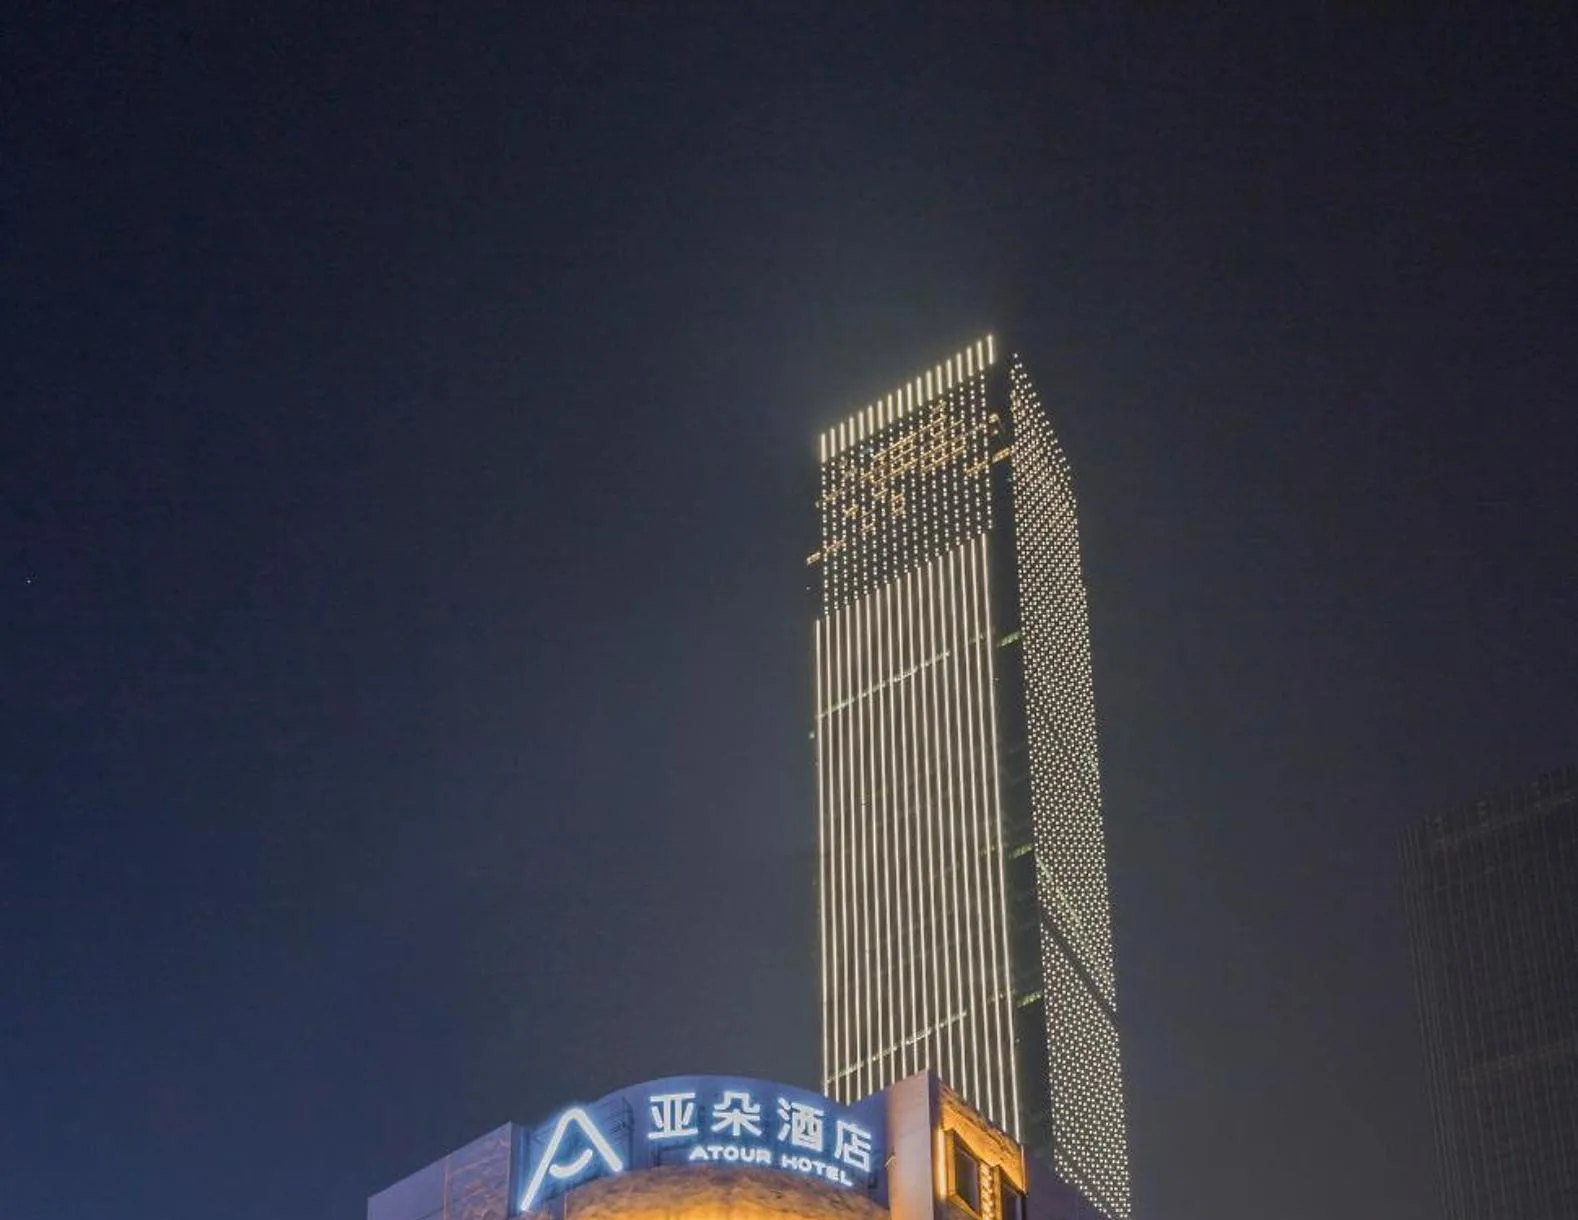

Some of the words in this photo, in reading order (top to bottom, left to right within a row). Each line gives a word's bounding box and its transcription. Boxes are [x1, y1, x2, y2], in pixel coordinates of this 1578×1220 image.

[647, 1091, 873, 1173] 亚朵酒店
[689, 1145, 771, 1164] ATOUR
[781, 1154, 854, 1187] HOTEL
